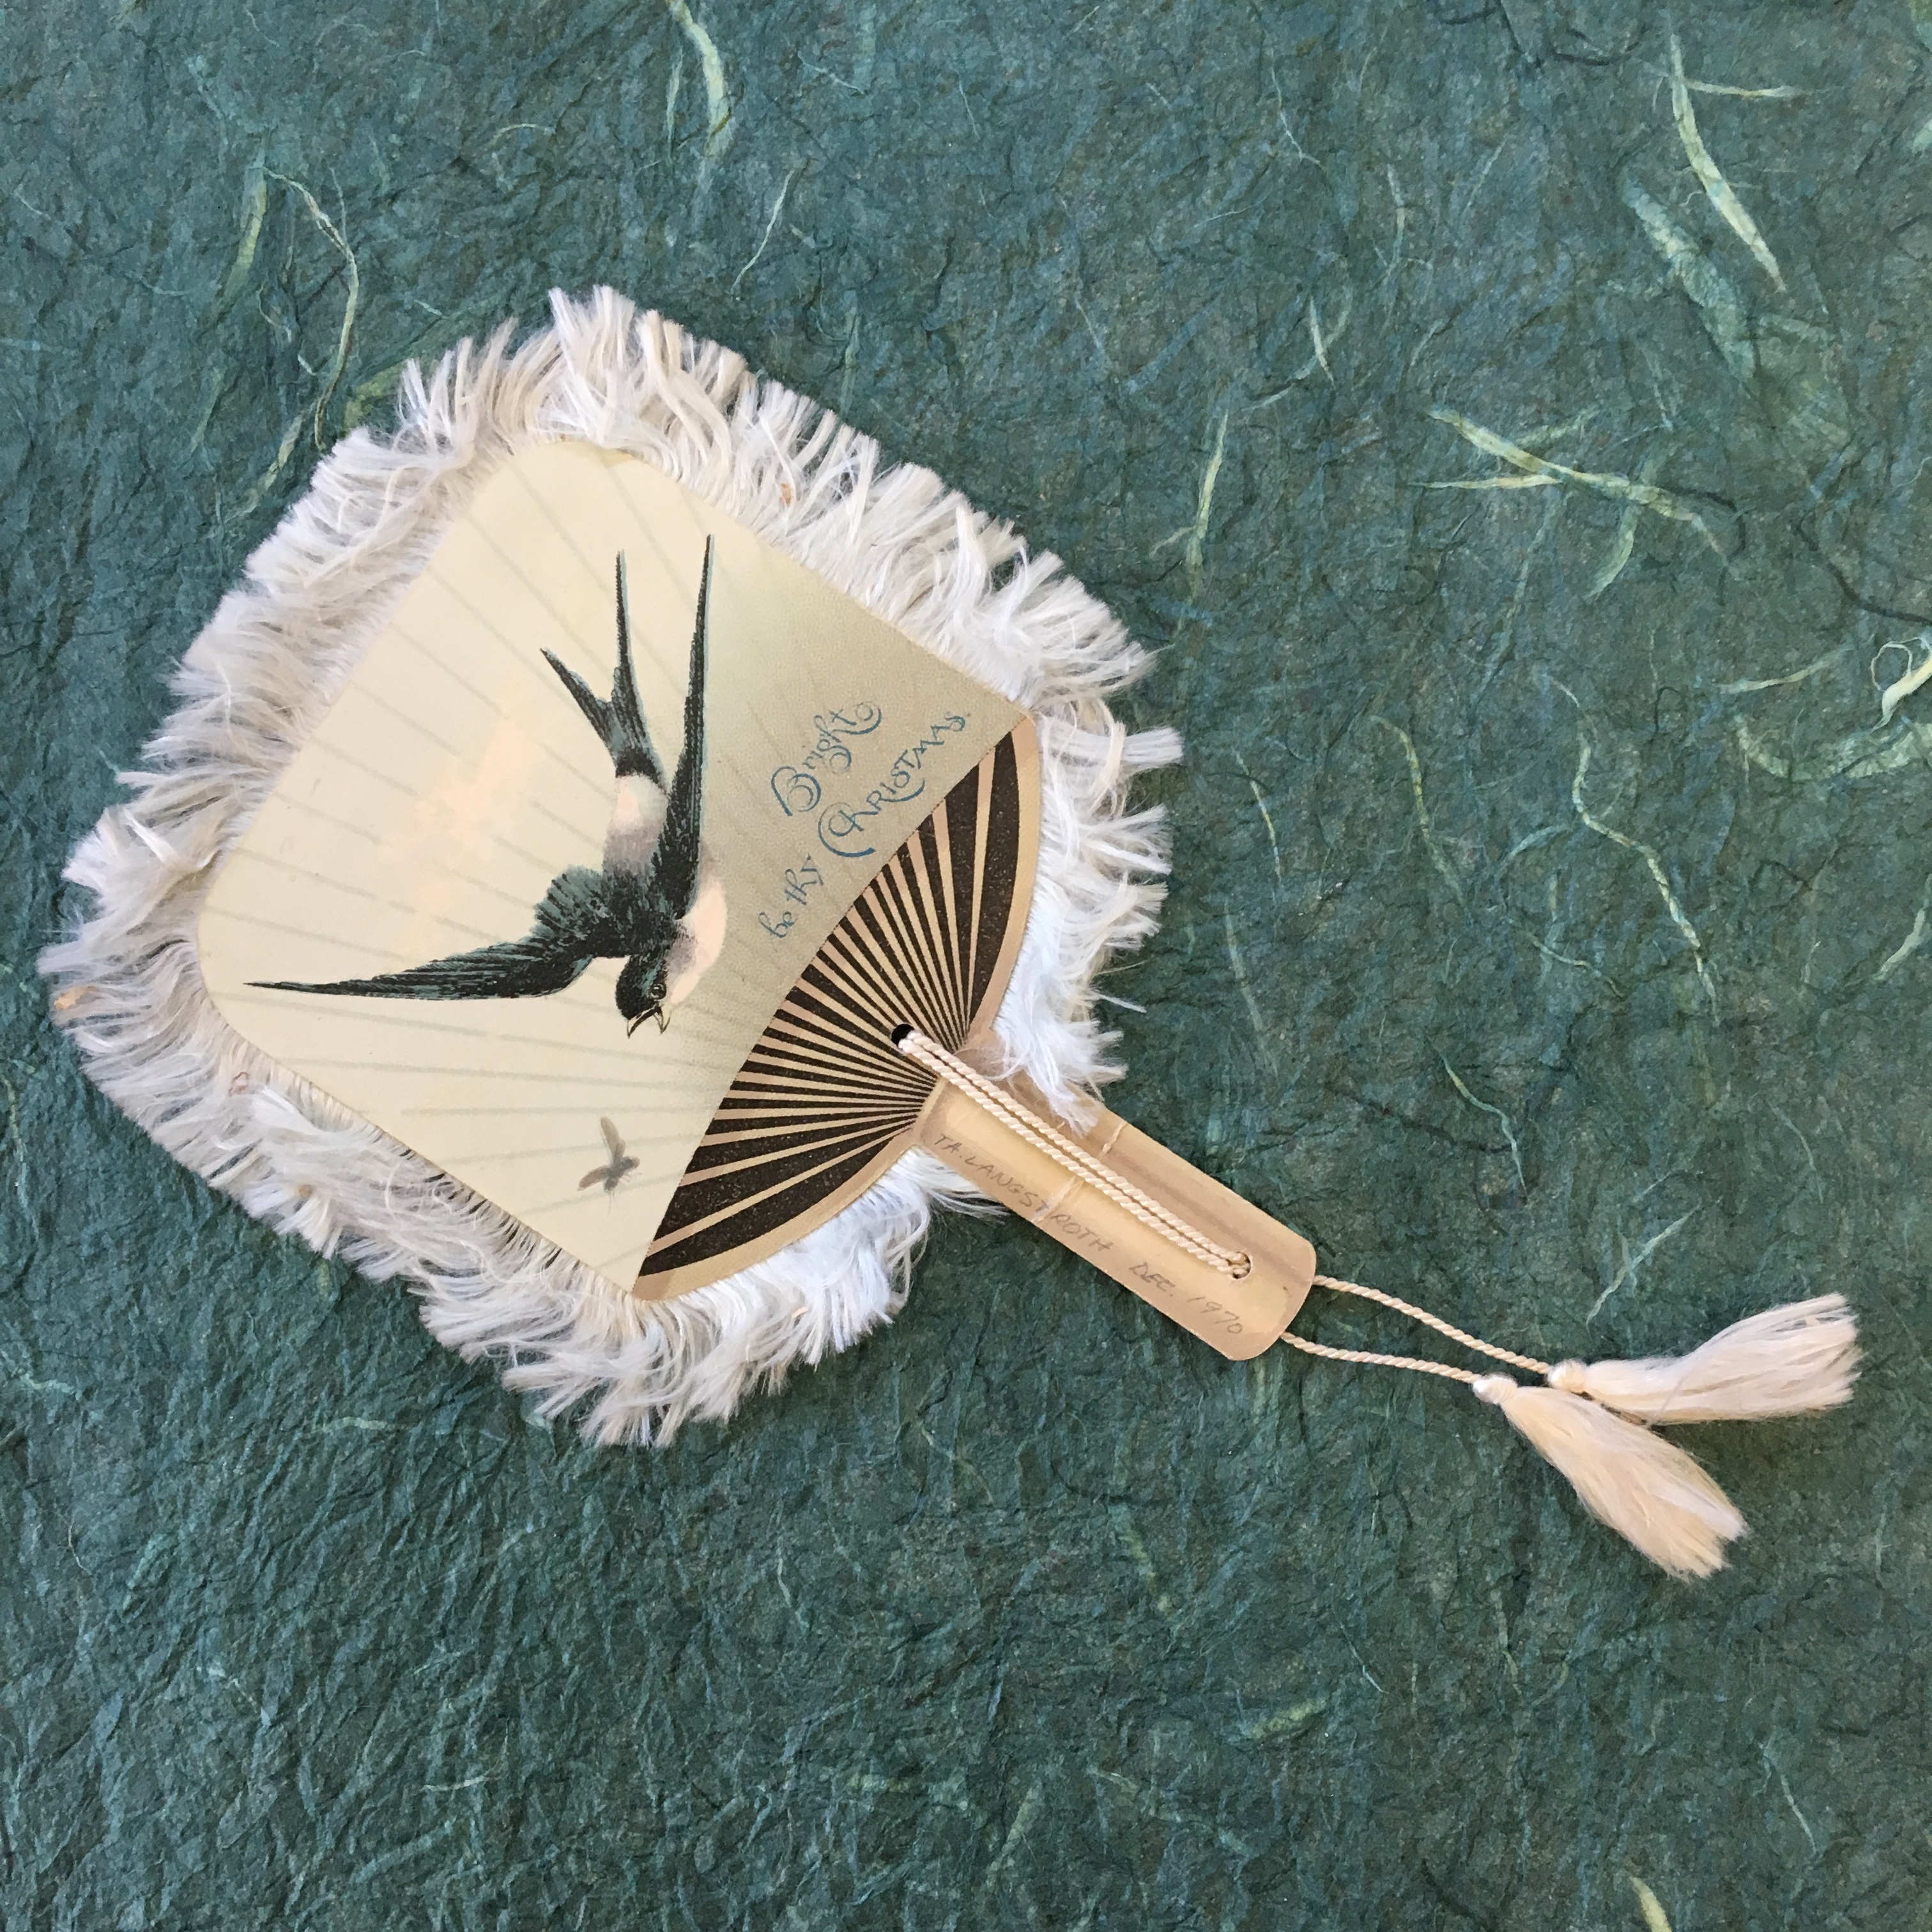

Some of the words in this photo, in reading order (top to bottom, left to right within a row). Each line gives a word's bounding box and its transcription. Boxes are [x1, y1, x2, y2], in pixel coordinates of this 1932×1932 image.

[770, 702, 882, 816] Bright
[758, 910, 797, 939] be
[785, 854, 824, 905] thy
[1188, 1296, 1244, 1335] 1970
